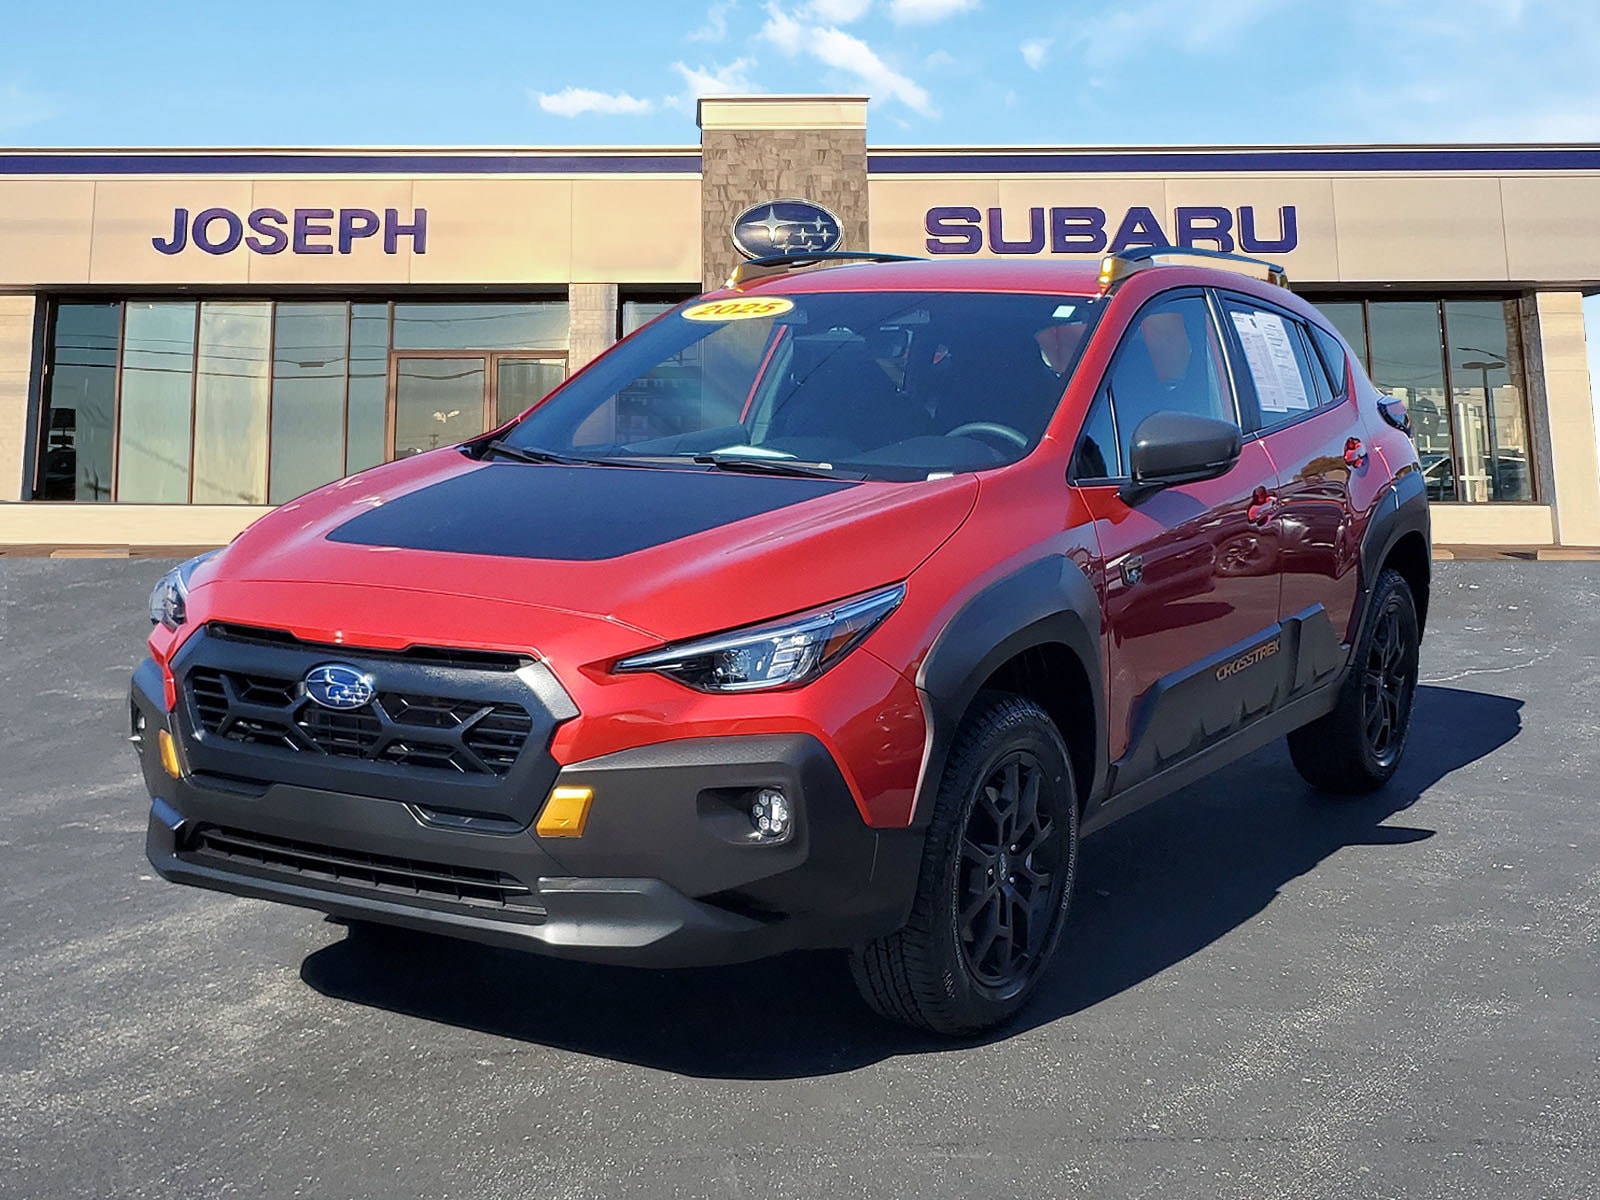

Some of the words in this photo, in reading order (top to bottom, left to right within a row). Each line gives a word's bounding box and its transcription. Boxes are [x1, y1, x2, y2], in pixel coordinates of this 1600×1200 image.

[152, 208, 427, 254] JOSEPH
[925, 206, 1298, 254] SUBARU
[692, 302, 785, 317] 2025
[1215, 638, 1280, 681] CROSSTREK
